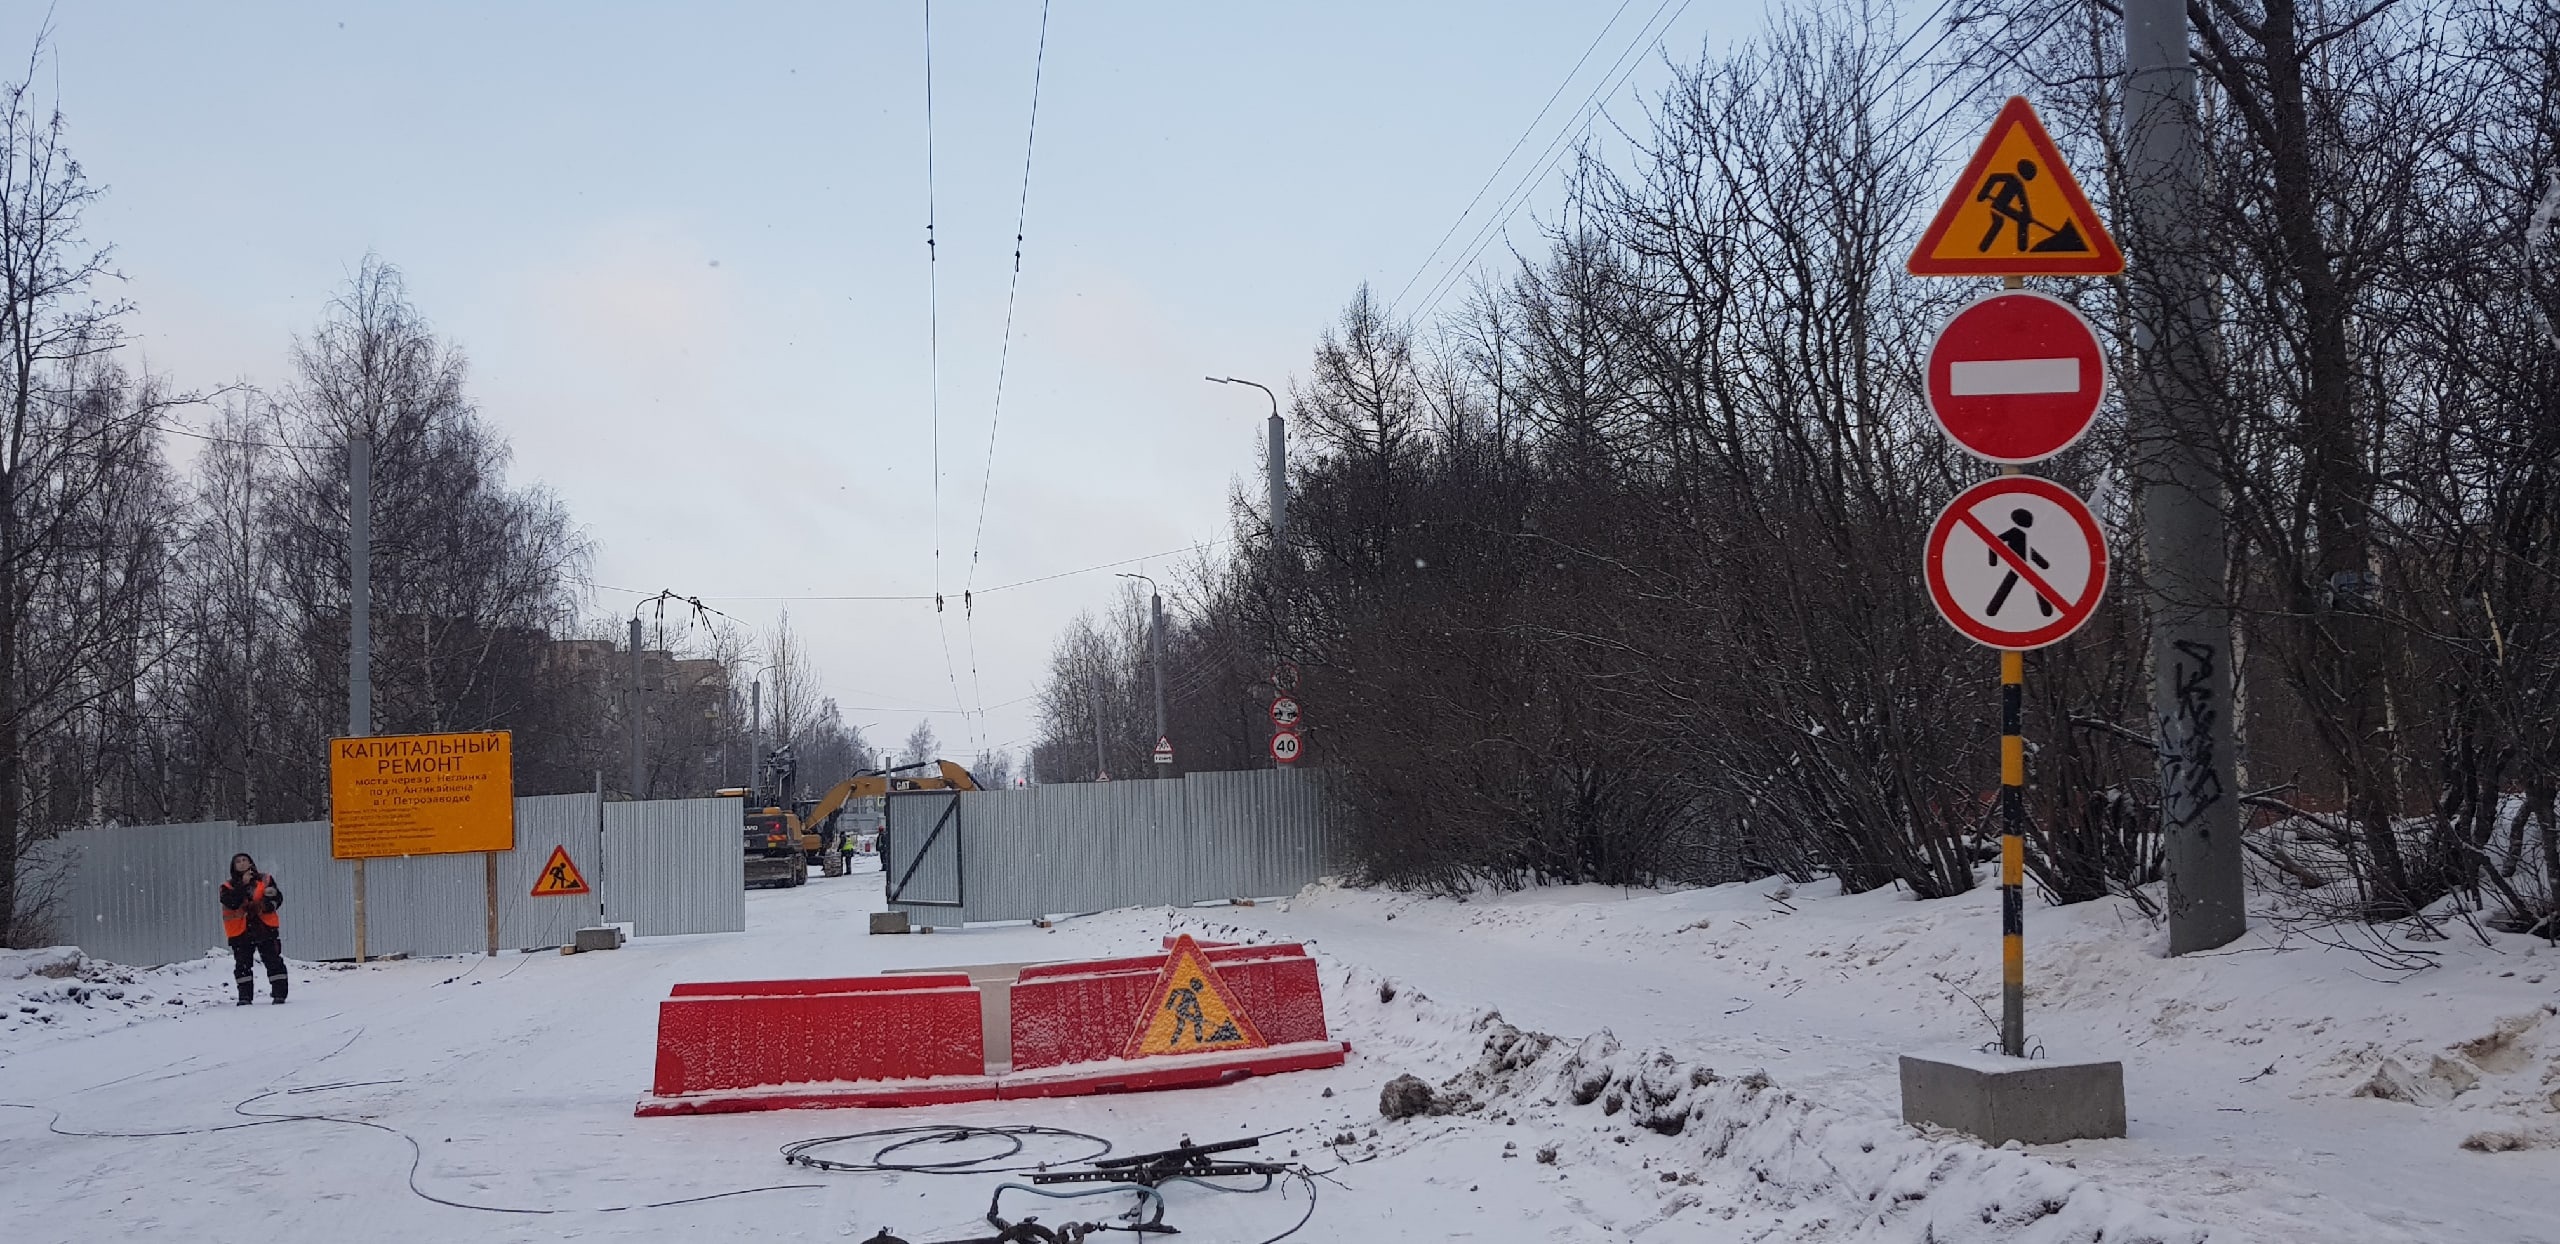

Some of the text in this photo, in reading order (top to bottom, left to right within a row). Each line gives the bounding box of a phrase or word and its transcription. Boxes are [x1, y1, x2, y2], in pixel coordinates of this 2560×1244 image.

[342, 734, 500, 759] КАПИТАЛЬНЫЙ
[1276, 740, 1295, 752] 40
[378, 756, 463, 774] РЕМОНТ
[356, 777, 389, 786] моста
[391, 776, 422, 785] через
[896, 780, 910, 791] CAT
[370, 788, 382, 796] по
